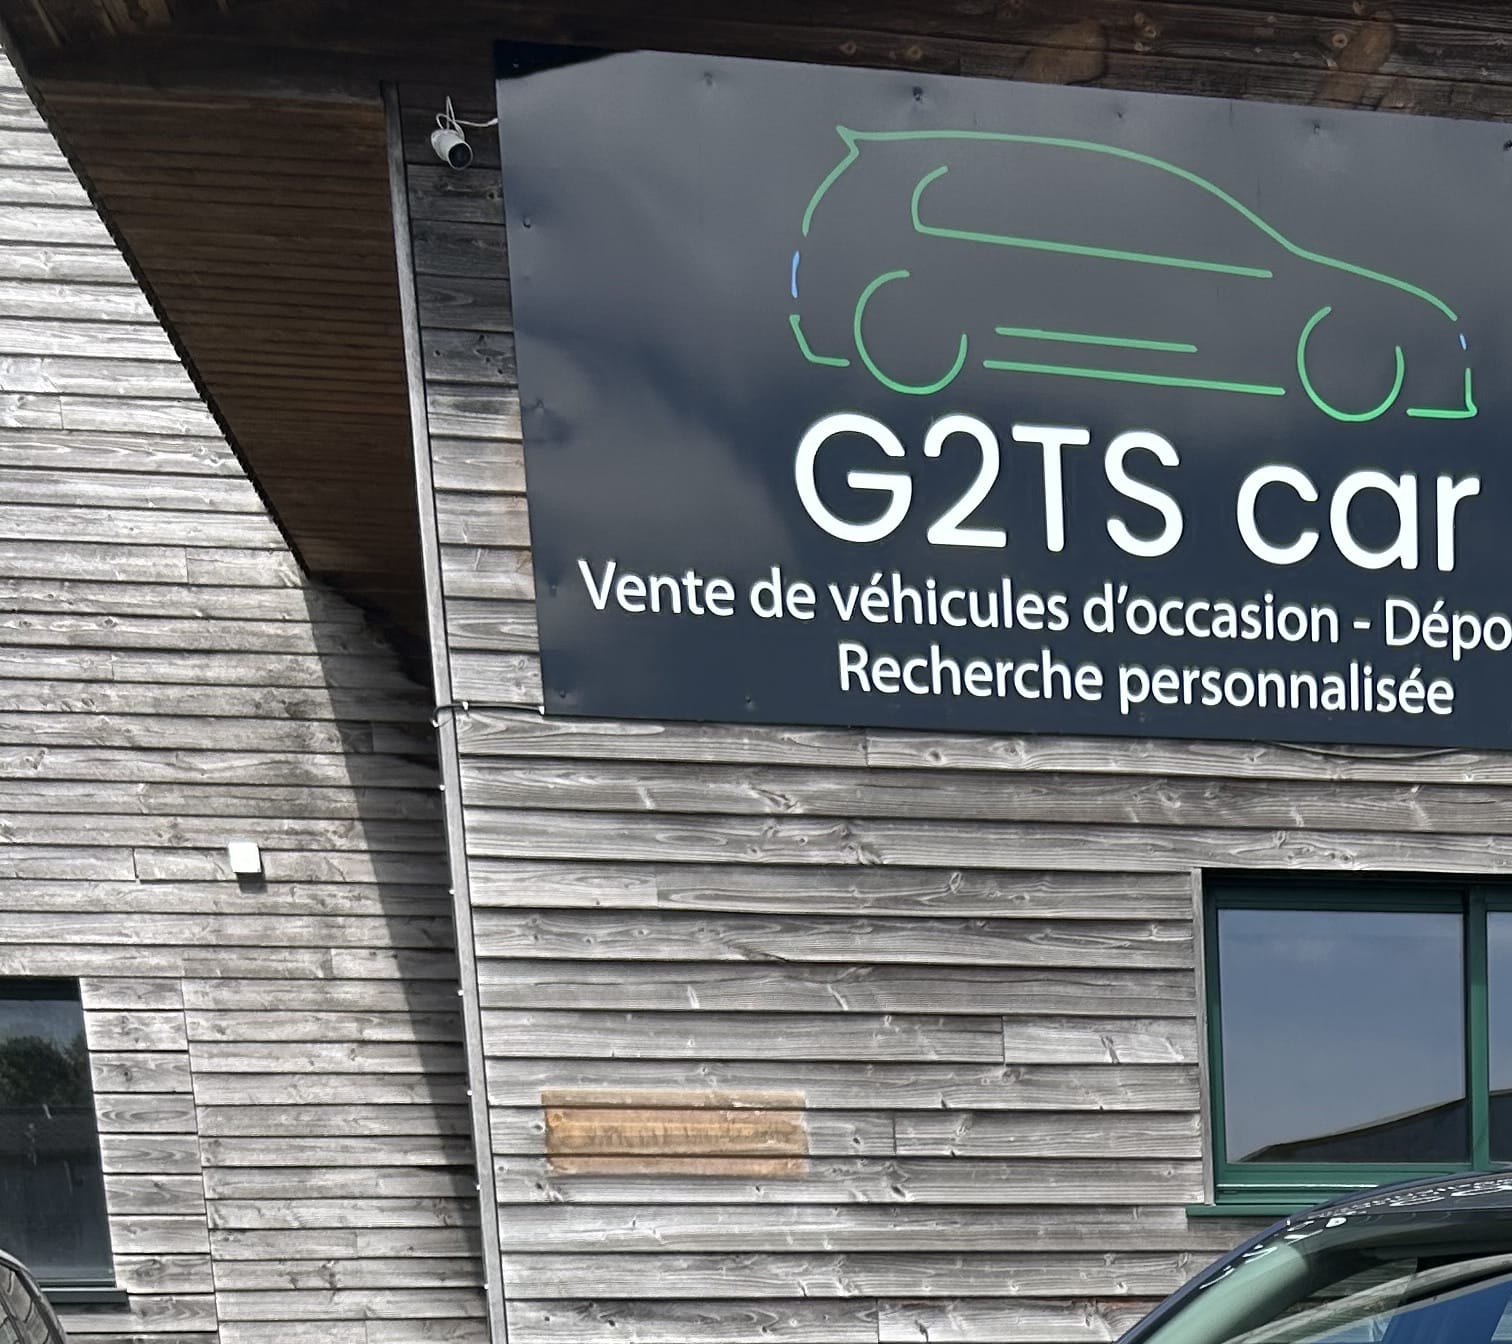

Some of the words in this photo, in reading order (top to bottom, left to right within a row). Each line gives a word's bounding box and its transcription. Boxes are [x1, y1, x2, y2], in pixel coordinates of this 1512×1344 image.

[795, 413, 1184, 558] G2TS
[1237, 465, 1481, 573] car
[577, 559, 735, 617] Vente
[750, 565, 816, 620] de
[828, 571, 1069, 632] véhicules
[1353, 620, 1371, 629] -
[838, 643, 1103, 701] Recherche
[1119, 662, 1454, 715] personnalisée
